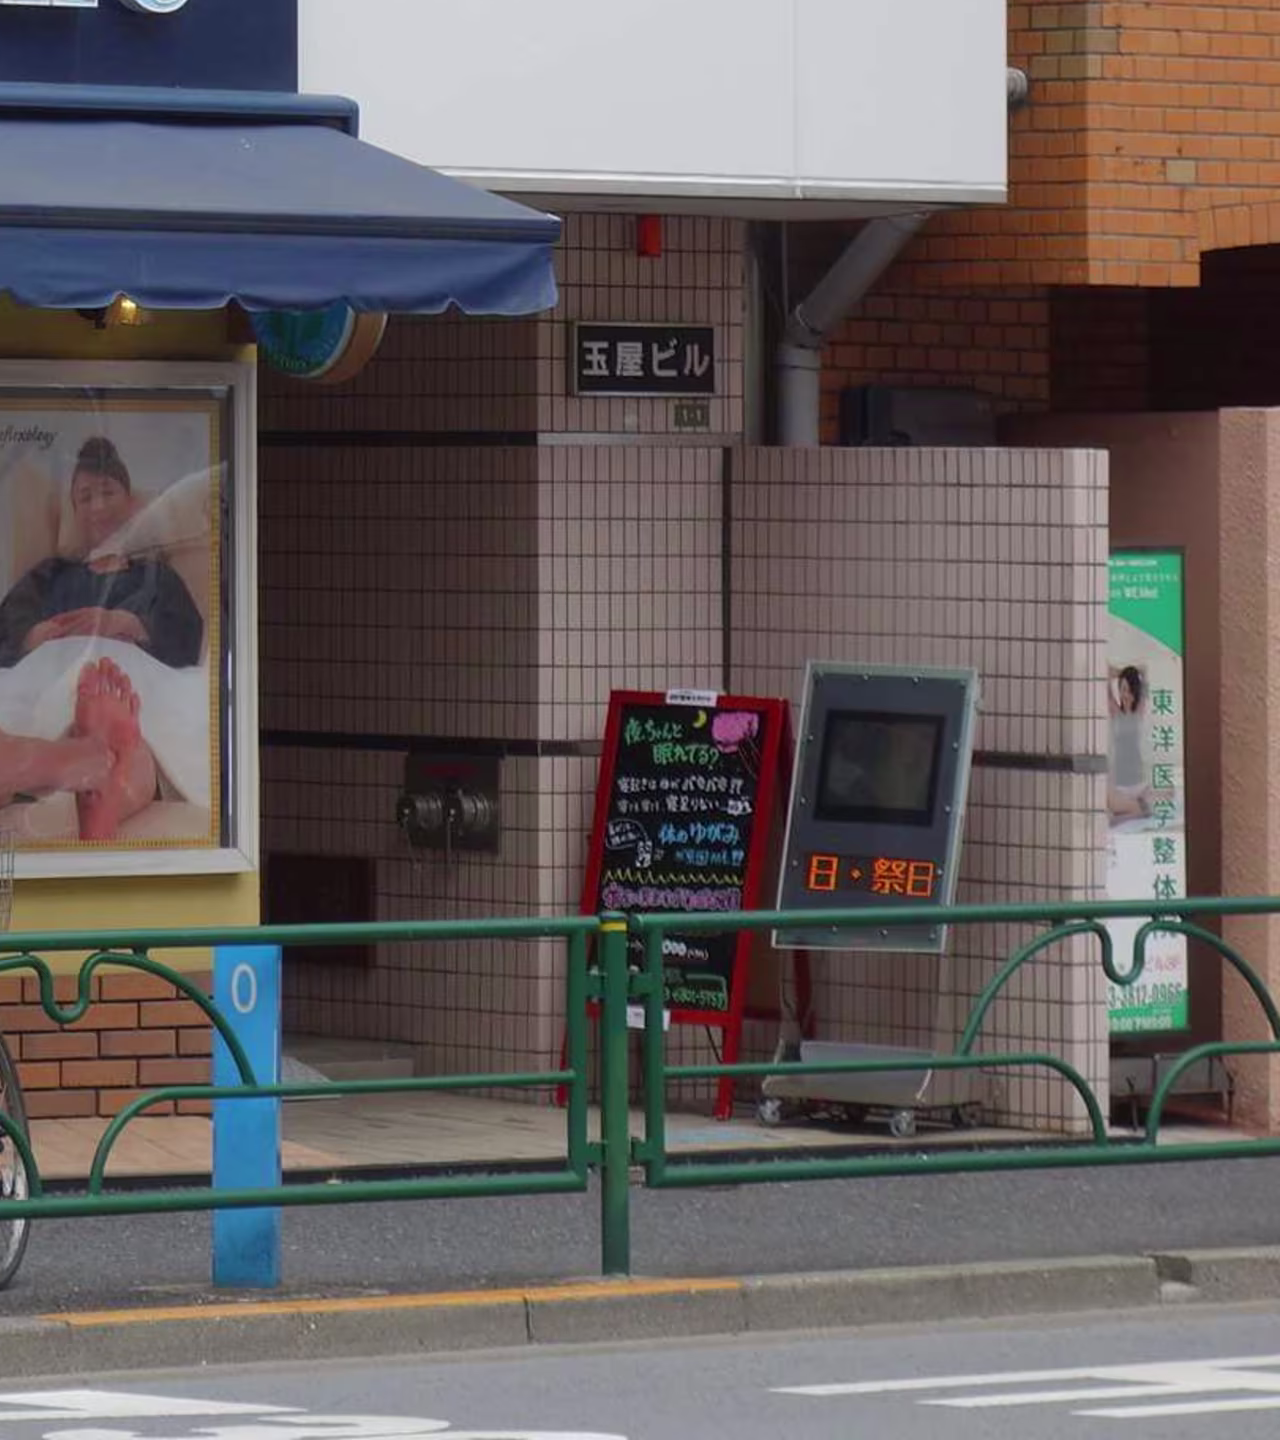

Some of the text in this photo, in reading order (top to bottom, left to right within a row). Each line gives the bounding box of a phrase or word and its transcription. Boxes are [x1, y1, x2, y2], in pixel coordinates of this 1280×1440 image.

[581, 338, 711, 378] 玉屋ビル
[1150, 688, 1179, 939] 東洋医学整体
